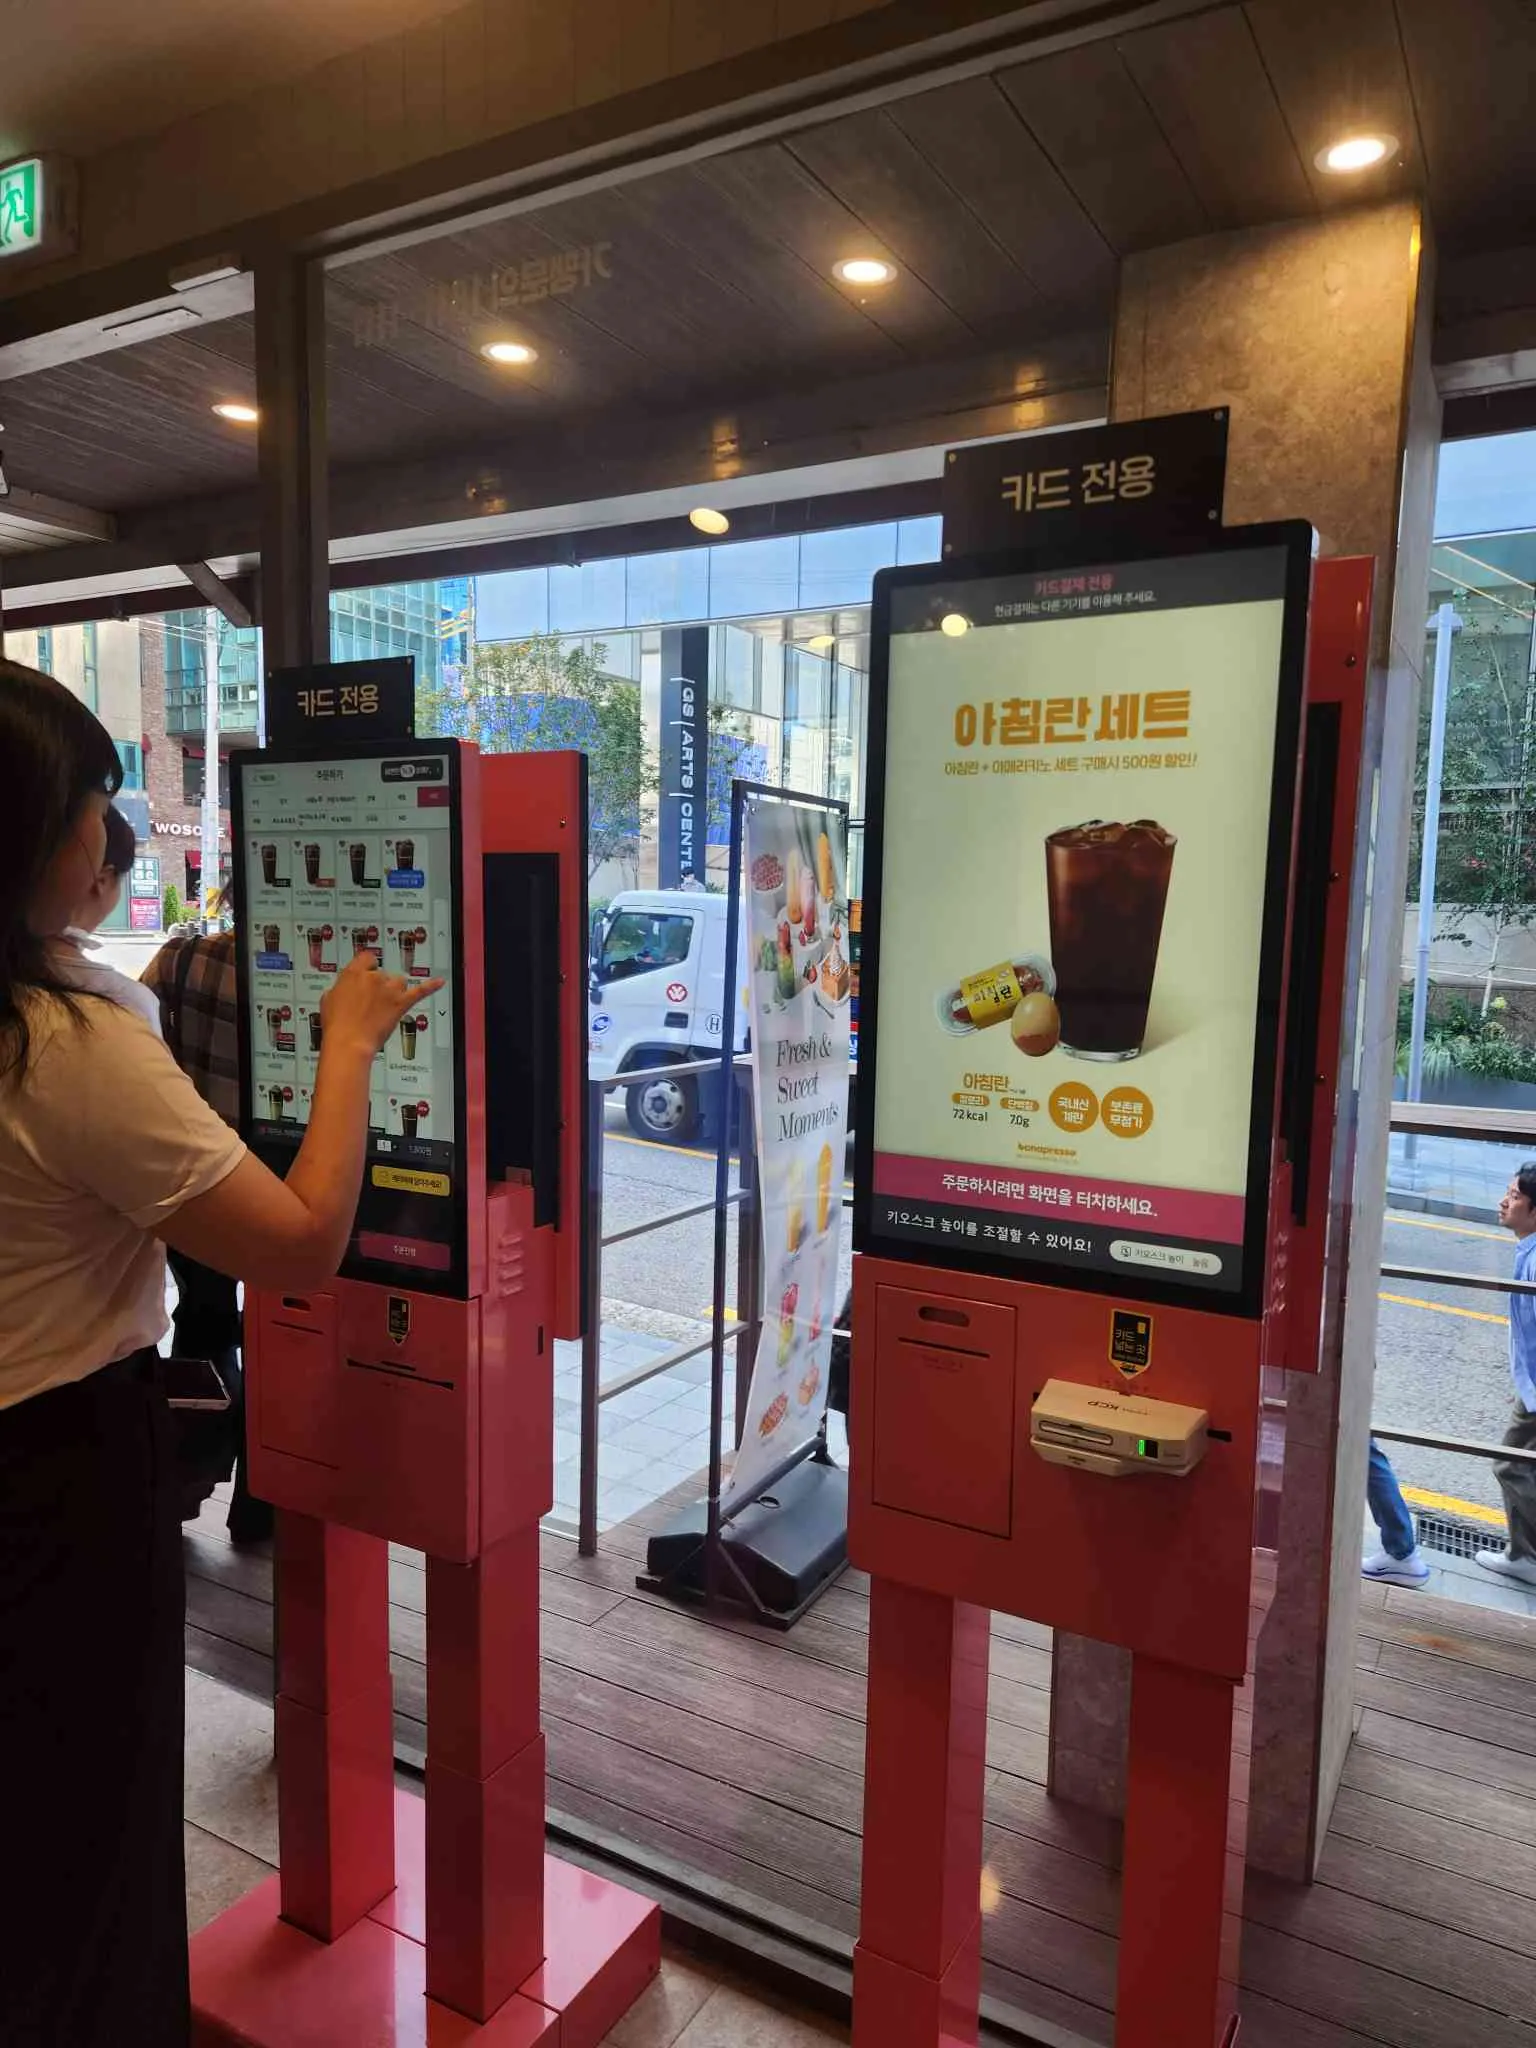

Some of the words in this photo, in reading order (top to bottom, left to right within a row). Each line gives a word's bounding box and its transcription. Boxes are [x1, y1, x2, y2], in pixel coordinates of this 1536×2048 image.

[1001, 468, 1071, 512] 카드
[1081, 455, 1156, 504] 전용
[297, 689, 335, 717] 카드
[339, 684, 379, 715] 전용
[1053, 755, 1079, 772] 세트
[1122, 753, 1162, 770] 500원
[148, 820, 226, 839] WOSOE
[680, 802, 693, 870] CENTE
[776, 1035, 816, 1068] Fresh
[819, 1033, 832, 1058] &
[777, 1072, 819, 1105] Sweet
[963, 1072, 1010, 1094] 아침란
[1057, 1096, 1090, 1112] 국내산
[777, 1101, 839, 1142] Moments
[941, 1173, 1026, 1201] 주문하시려면
[1028, 1184, 1073, 1207] 화면을
[1076, 1190, 1159, 1218] 터치하세요.
[887, 1209, 936, 1230] 키오스크
[940, 1216, 978, 1237] 높이를
[983, 1224, 1023, 1244] 조절할
[1027, 1230, 1041, 1246] 수
[1046, 1233, 1092, 1254] 있어요!
